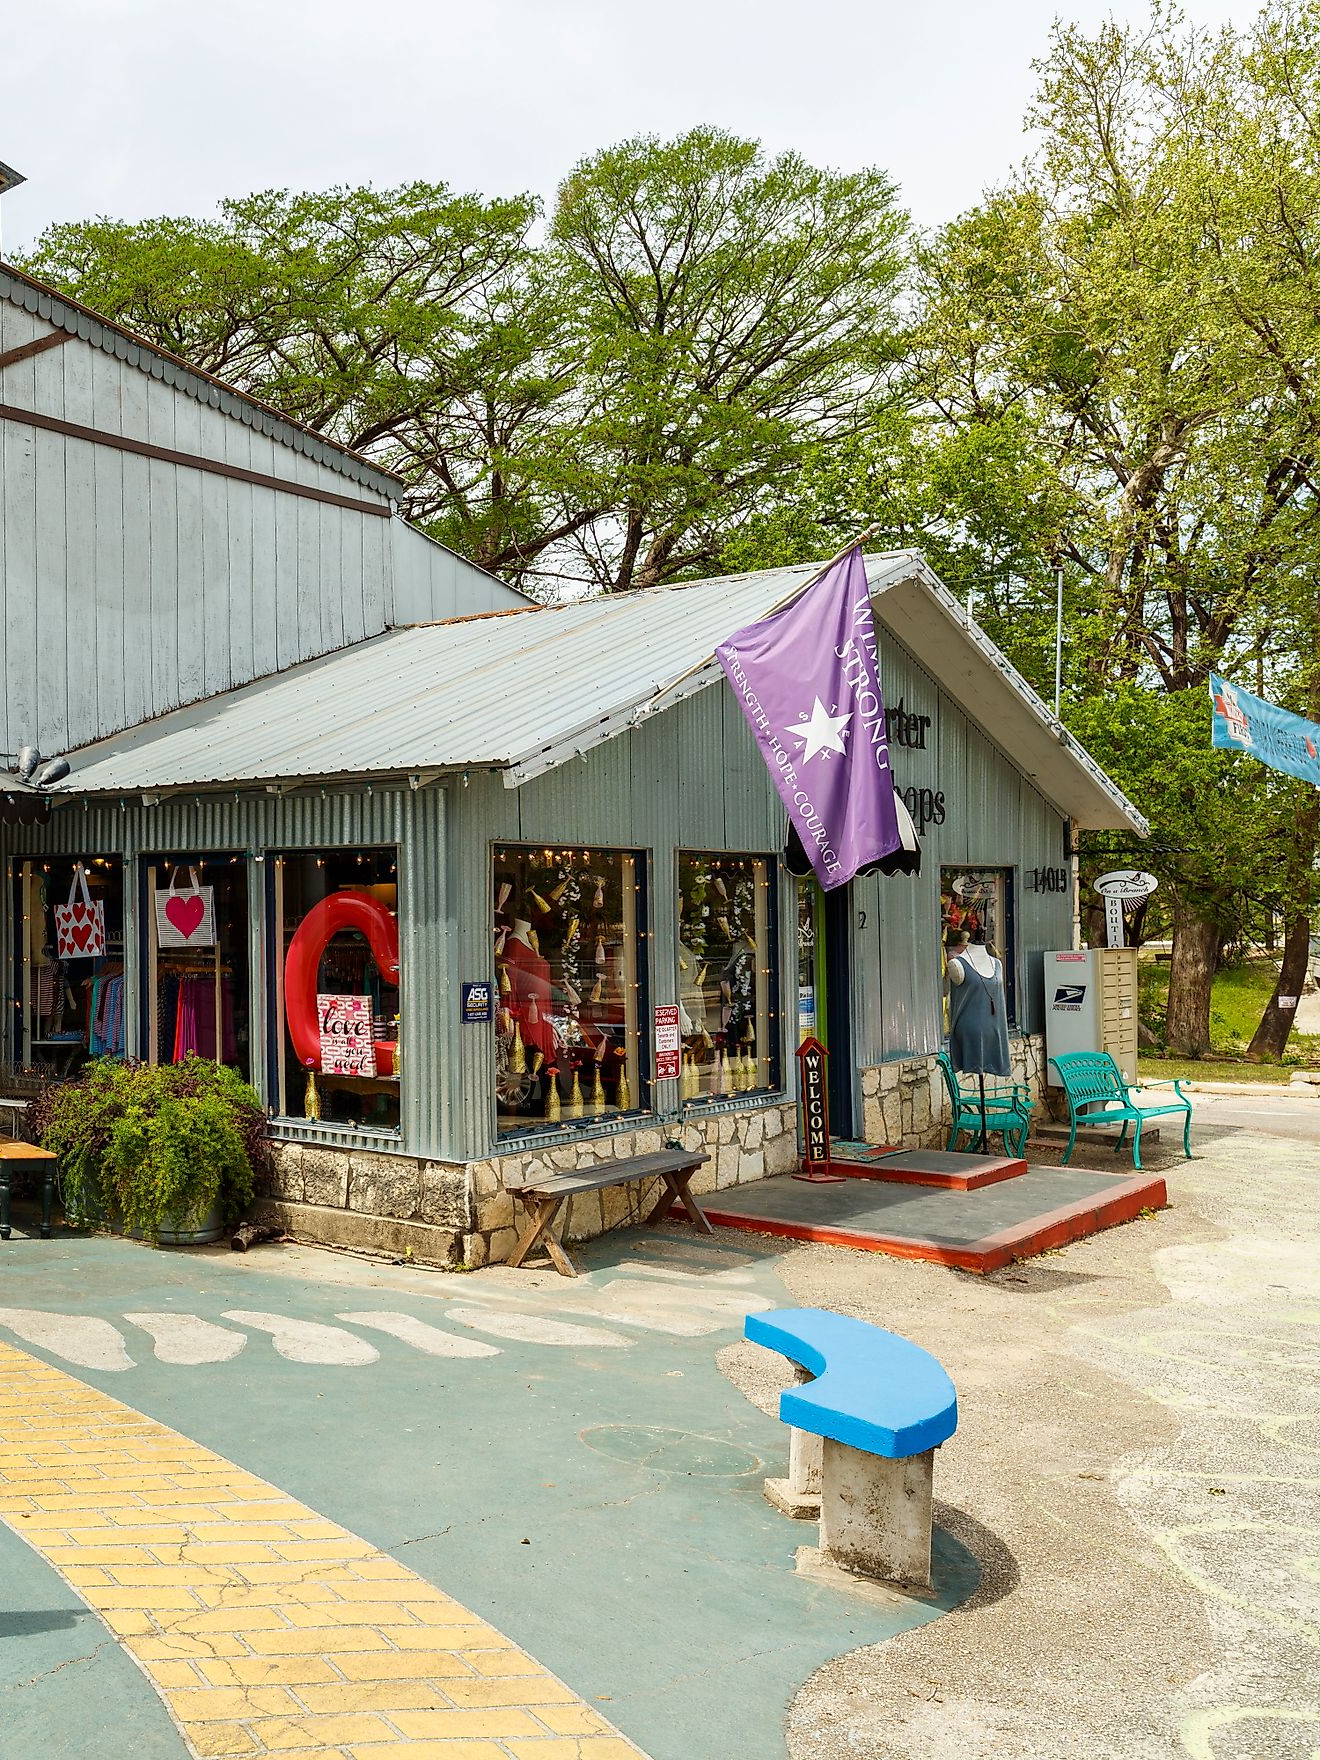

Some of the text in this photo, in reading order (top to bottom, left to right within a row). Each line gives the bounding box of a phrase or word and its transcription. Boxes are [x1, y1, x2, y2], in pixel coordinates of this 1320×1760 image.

[834, 638, 890, 770] STRONG
[724, 645, 842, 874] STRENGTH HOPE COURAGE
[857, 910, 868, 930] 2
[467, 987, 488, 1001] ASG
[323, 1006, 367, 1036] love
[340, 1036, 352, 1046] all
[344, 1047, 363, 1058] you
[334, 1055, 367, 1071] need
[805, 1055, 825, 1160] WELCOME
